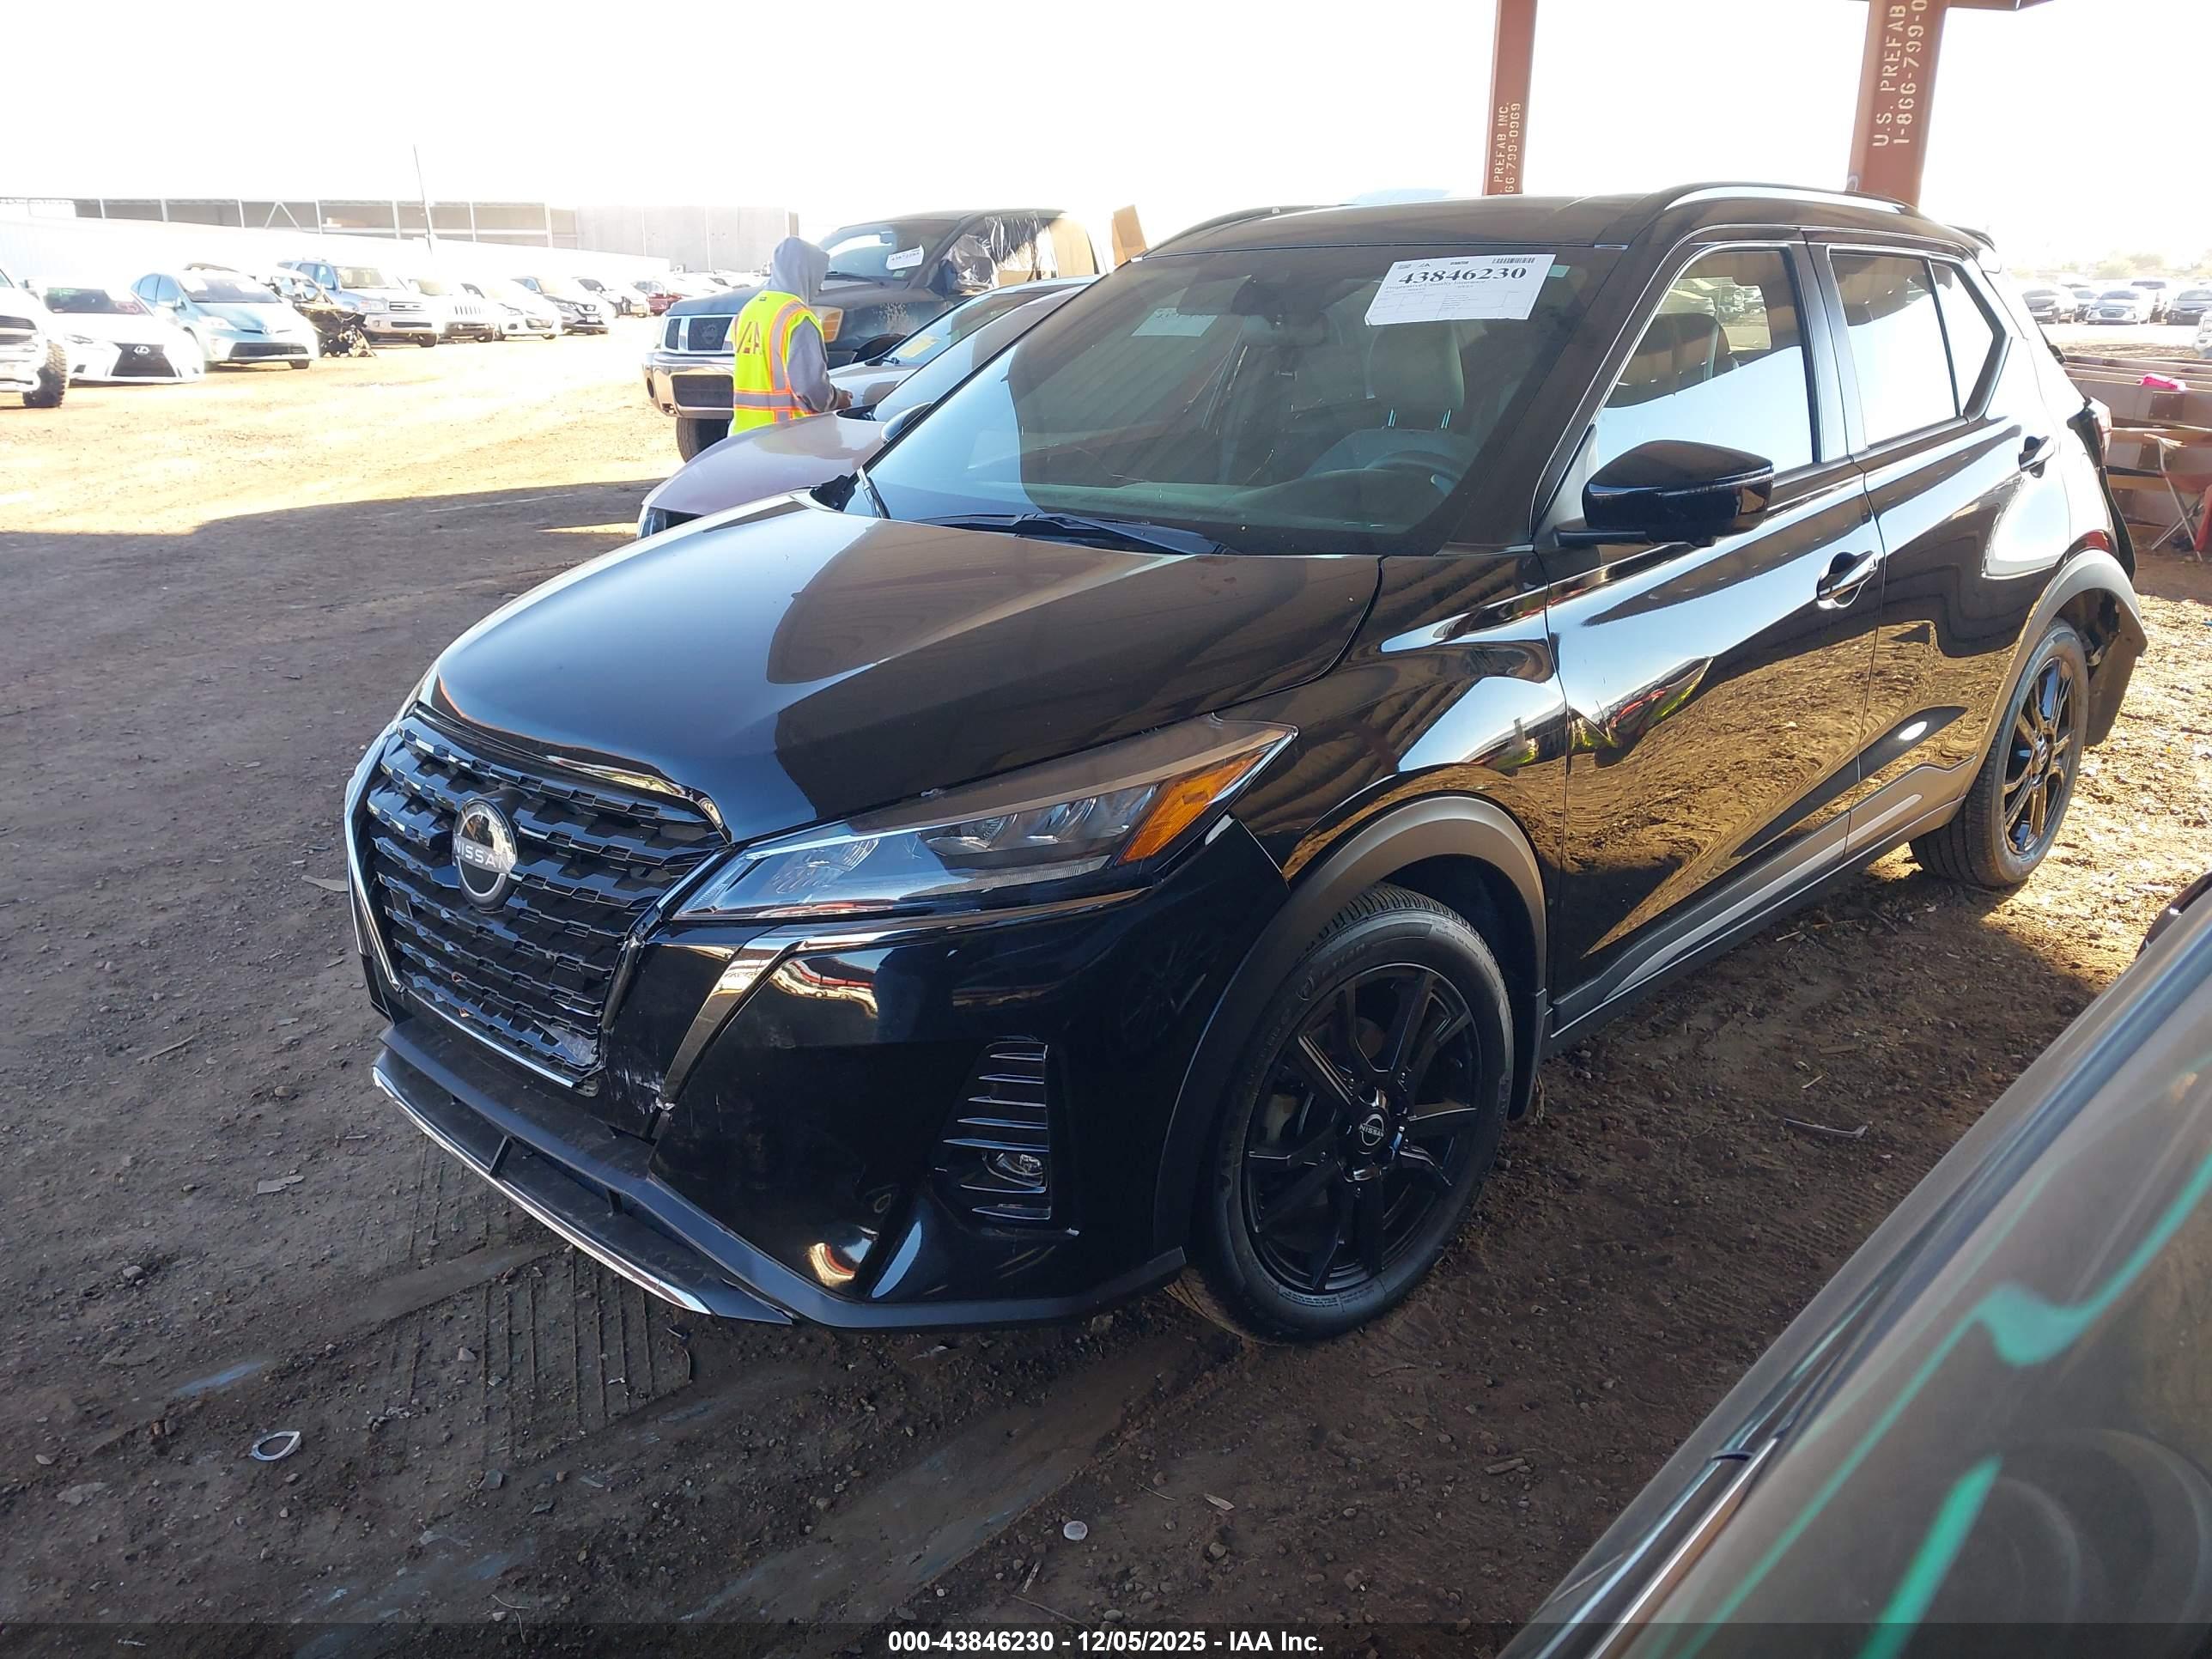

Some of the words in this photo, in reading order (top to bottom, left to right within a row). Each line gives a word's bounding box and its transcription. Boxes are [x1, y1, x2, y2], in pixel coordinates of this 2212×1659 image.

[1880, 4, 1906, 92] PREFAB
[1497, 102, 1510, 126] INC.
[1872, 105, 1893, 147] U.S.
[1493, 133, 1507, 183] PREFAB
[1398, 267, 1527, 284] 43846230
[453, 838, 515, 872] NISSAN
[1359, 1124, 1384, 1138] NISSAN
